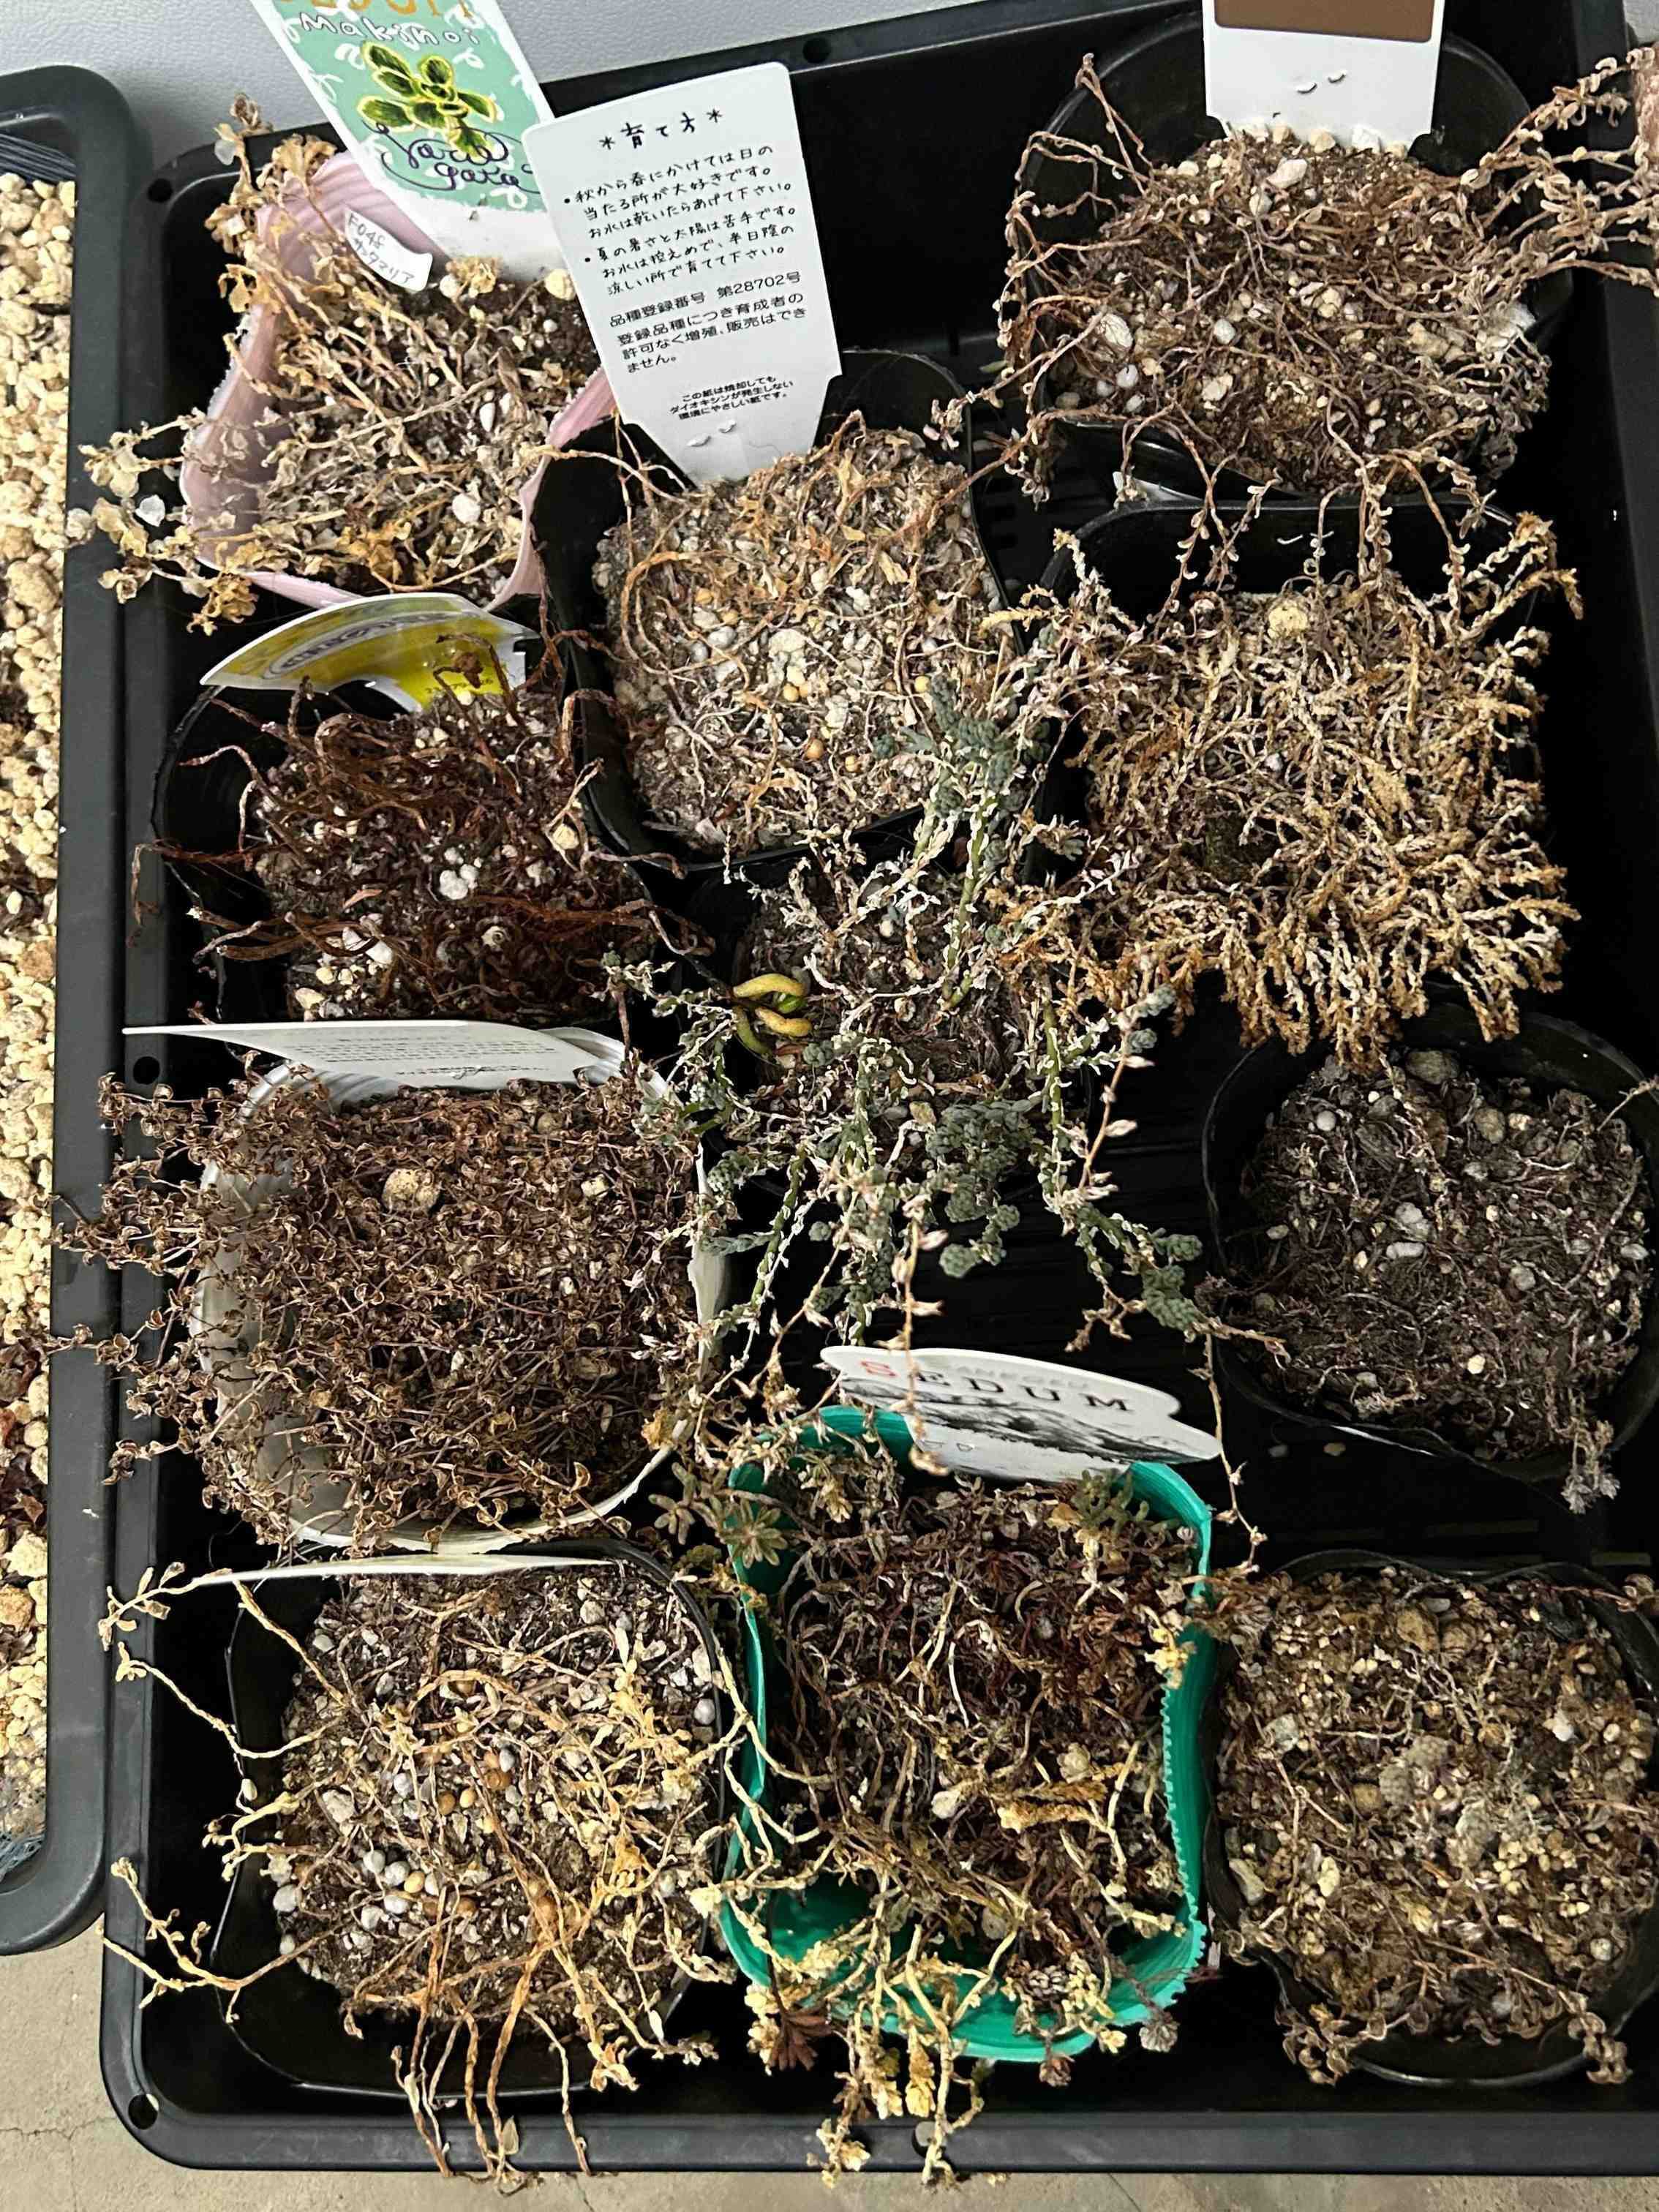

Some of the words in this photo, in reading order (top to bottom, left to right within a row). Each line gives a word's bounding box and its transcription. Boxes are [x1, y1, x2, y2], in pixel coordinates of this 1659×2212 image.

[300, 12, 480, 45] Makinoi
[609, 292, 706, 328] 品種登録番号
[716, 271, 801, 299] 第28702号
[617, 293, 804, 347] 登録品種につき育成者の
[622, 308, 807, 360] 許可なく増殖、販売はでき
[627, 354, 677, 373] ません。
[669, 380, 794, 415] ダイオキシンが発生しない
[682, 375, 776, 402] この紙は焼却しても
[859, 1359, 1134, 1412] SEDUM
